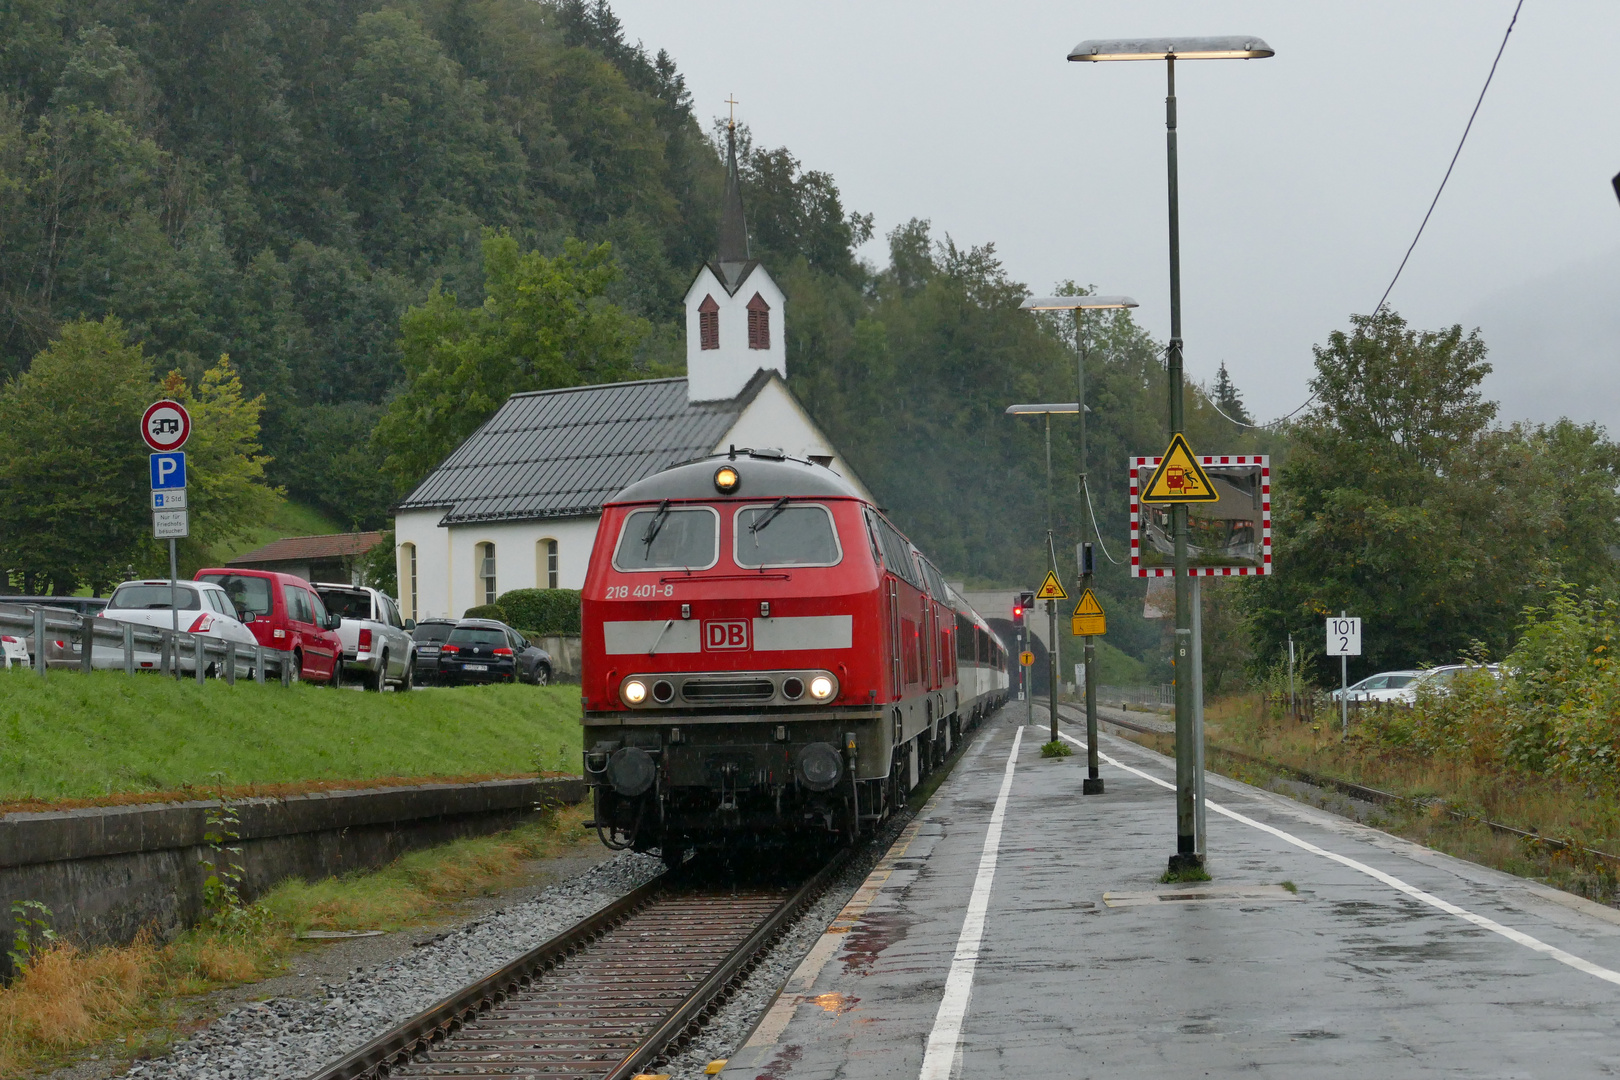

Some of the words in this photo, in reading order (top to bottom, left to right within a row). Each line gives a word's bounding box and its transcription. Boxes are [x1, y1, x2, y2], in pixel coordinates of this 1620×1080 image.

[158, 457, 177, 485] P
[165, 495, 170, 503] 2
[605, 586, 629, 599] 218
[632, 584, 674, 598] 401-8
[709, 624, 745, 646] DB
[1332, 620, 1355, 635] 101
[1339, 636, 1349, 651] 2
[1179, 648, 1186, 657] 8
